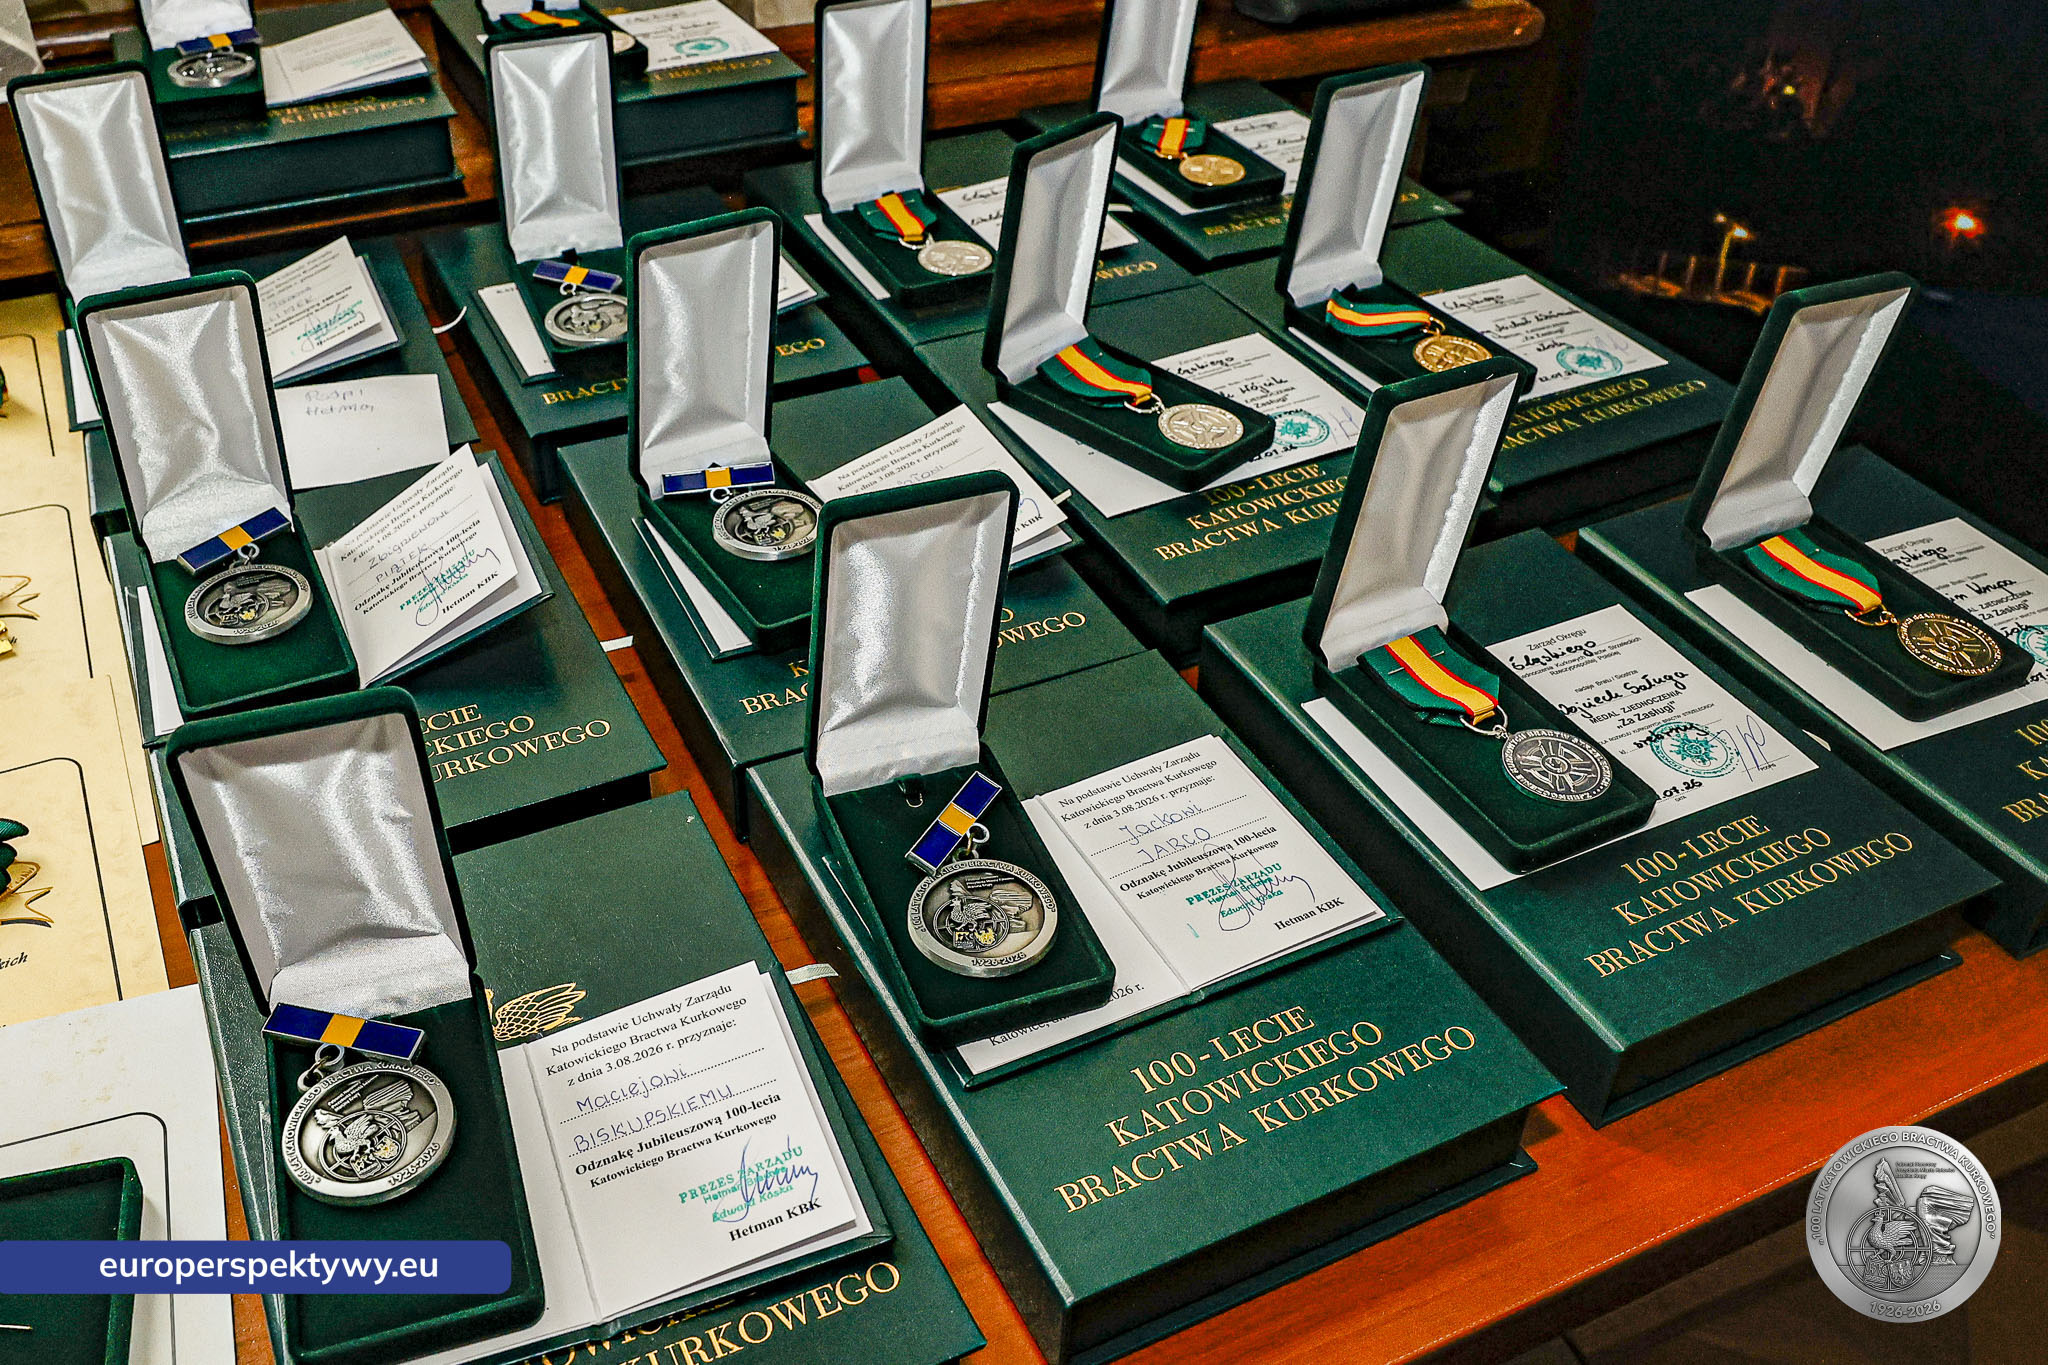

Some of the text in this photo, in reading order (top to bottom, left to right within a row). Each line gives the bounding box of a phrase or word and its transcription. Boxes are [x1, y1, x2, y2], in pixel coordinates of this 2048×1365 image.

[924, 420, 954, 438] Zarządu
[1581, 379, 1707, 424] KURKOWEGO
[421, 468, 464, 501] Kurkowego
[838, 423, 966, 491] Katowickiego Bractwa Kurkowego
[1187, 475, 1348, 530] KATOWICKIEG
[354, 583, 390, 611] Odznakę
[392, 541, 444, 584] Jubileuszową
[445, 518, 481, 545] 100-lecia
[1154, 518, 1282, 561] BRACTWA
[362, 578, 408, 615] Katowickiego
[438, 532, 478, 564] Kurkowego
[441, 583, 476, 614] Hetman
[477, 570, 499, 589] KBK
[1526, 629, 1586, 651] Zarząd Okręgu
[1589, 690, 1683, 724] MEDAL ZJEDNOCZENIA
[432, 720, 611, 783] URKOWEGO
[1058, 750, 1200, 807] Na podstawie Uchwały Zarządu
[1060, 759, 1217, 823] Katowickiego Bractwa Kurkowego
[1084, 821, 1091, 829] z
[1093, 812, 1112, 828] dnia
[1113, 794, 1159, 820] 3.08.2026
[1170, 775, 1215, 798] przyznaje:
[968, 860, 1015, 872] BRACTWA
[1119, 824, 1277, 892] Odznakę Jubileuszową 100-lecia
[1136, 839, 1279, 899] Katowickiego Bractwa Kurkowego
[1612, 827, 1832, 926] KATOWICKIEGO
[1185, 884, 1231, 906] PREZES
[1274, 897, 1345, 930] Hetman KBK
[1584, 832, 1914, 978] BRACTWA KURKOWEGO
[545, 997, 747, 1076] Katowickiego Bractwa Kurkowego
[552, 985, 732, 1056] Na podstawie Uchwały Zarządu
[321, 1064, 373, 1090] BRACTWA
[567, 1020, 737, 1087] z dnia 3.08.2026 r. przyznaje:
[1105, 1021, 1384, 1147] KATOWICKIEGO
[574, 1085, 733, 1152] BISKUPSKIEMU
[575, 1092, 781, 1176] Odznakę Jubileuszową 100-lecia
[1054, 1026, 1476, 1212] BRACTWA KURKOWEGO
[389, 1142, 440, 1185] 1926-2026
[590, 1112, 777, 1188] Katowickiego Bractwa Kurkowego
[679, 1173, 735, 1203] PREZES
[729, 1198, 822, 1241] Hetman KBK
